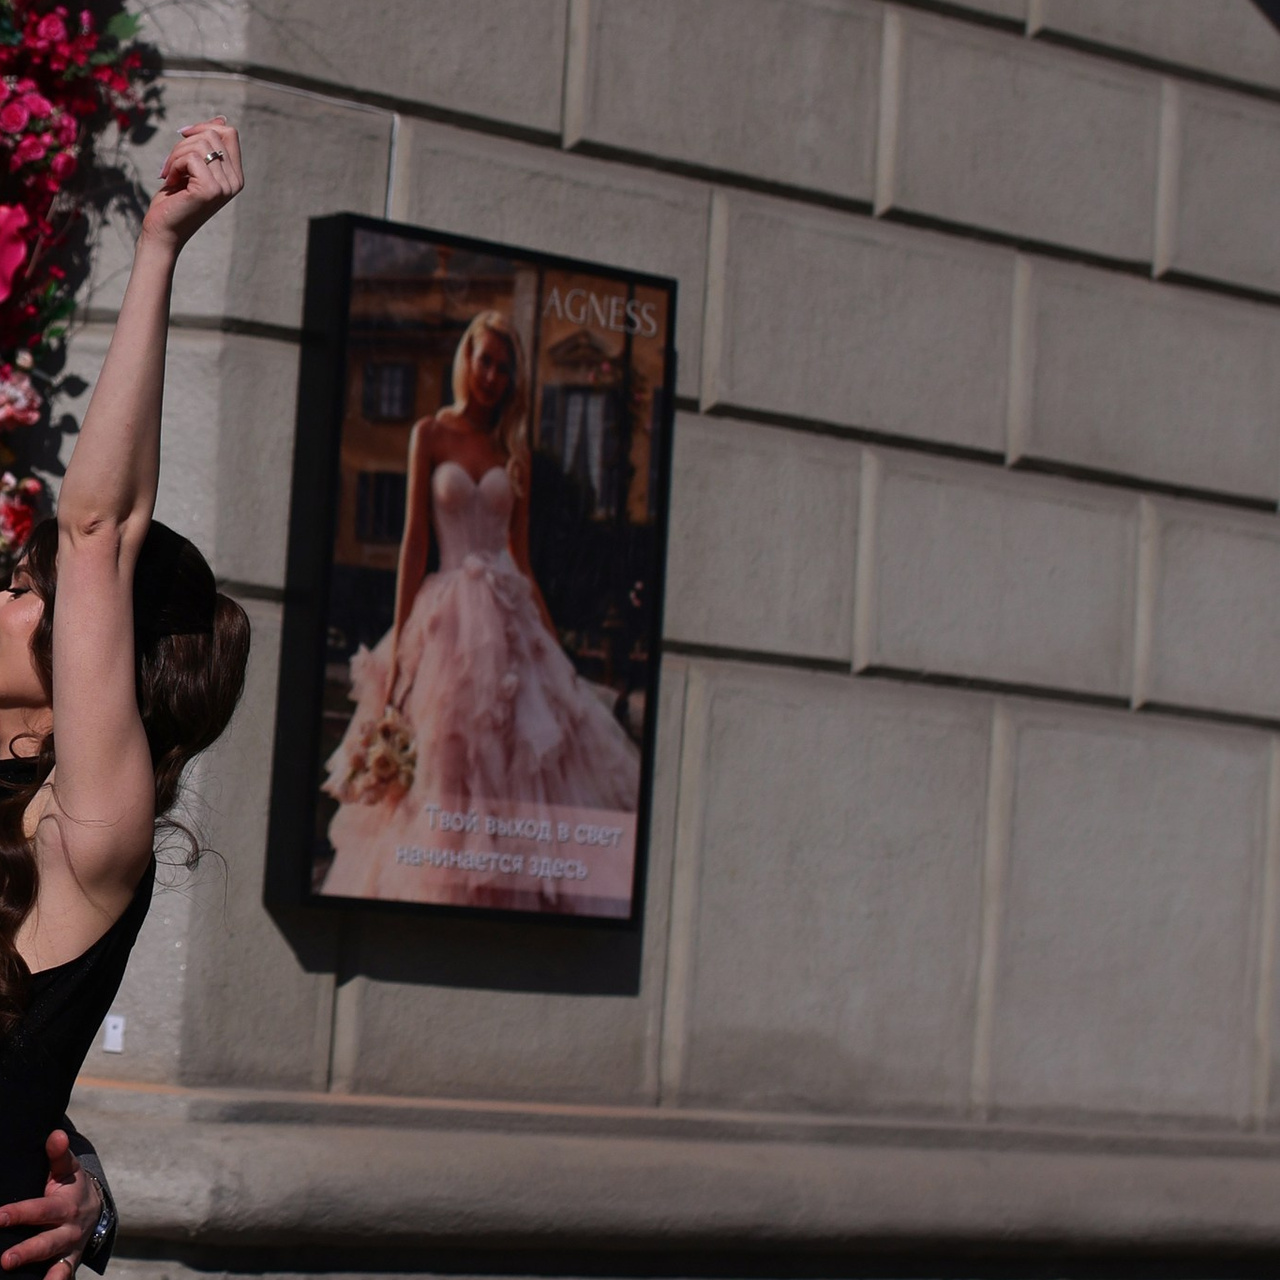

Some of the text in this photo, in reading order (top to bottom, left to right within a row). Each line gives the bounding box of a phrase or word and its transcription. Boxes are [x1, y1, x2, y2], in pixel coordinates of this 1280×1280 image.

[543, 286, 658, 338] AGNESS
[425, 804, 623, 848] Твой выход в свет
[396, 845, 588, 880] начинается здесь
